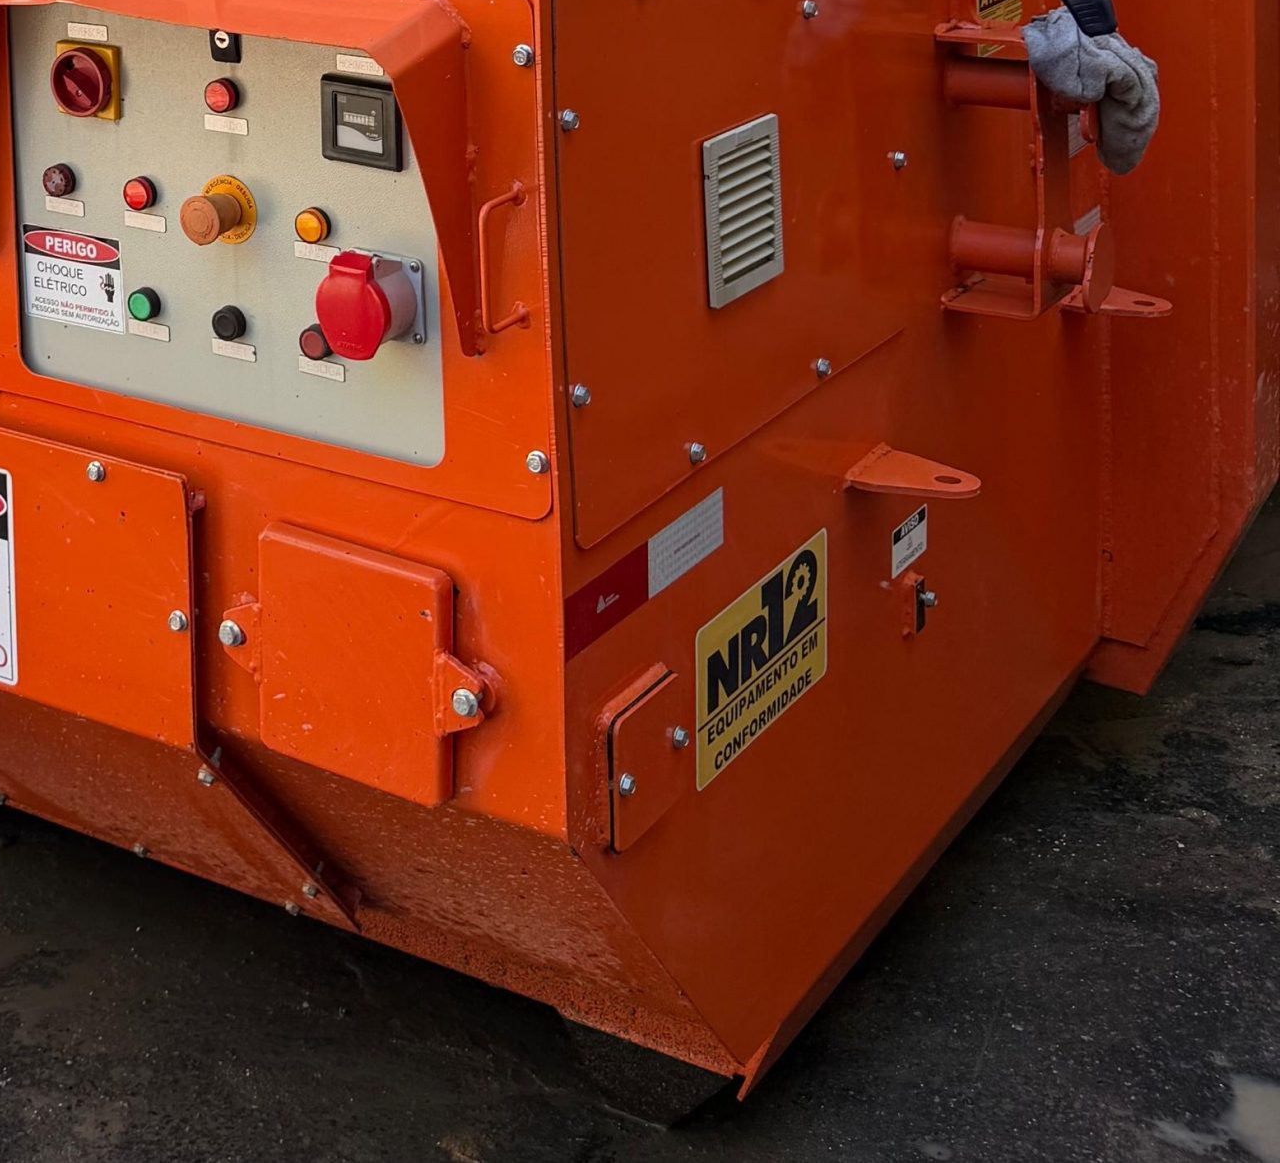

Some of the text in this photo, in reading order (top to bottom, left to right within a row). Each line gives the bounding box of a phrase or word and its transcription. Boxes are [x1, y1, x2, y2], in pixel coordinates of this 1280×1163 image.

[45, 236, 97, 258] PERIGO
[37, 261, 84, 280] CHOQUE
[34, 276, 87, 297] ELÉTRICO
[31, 303, 120, 327] PESSOAS SEM AUTORIZAÇÃO
[35, 296, 59, 307] ACESSO
[60, 301, 74, 310] NÃO
[75, 304, 109, 317] PERMITIDO
[707, 549, 819, 716] NR12
[707, 631, 819, 746] EQUIPAMENTO EM
[714, 668, 813, 771] CONFORMIDADE
